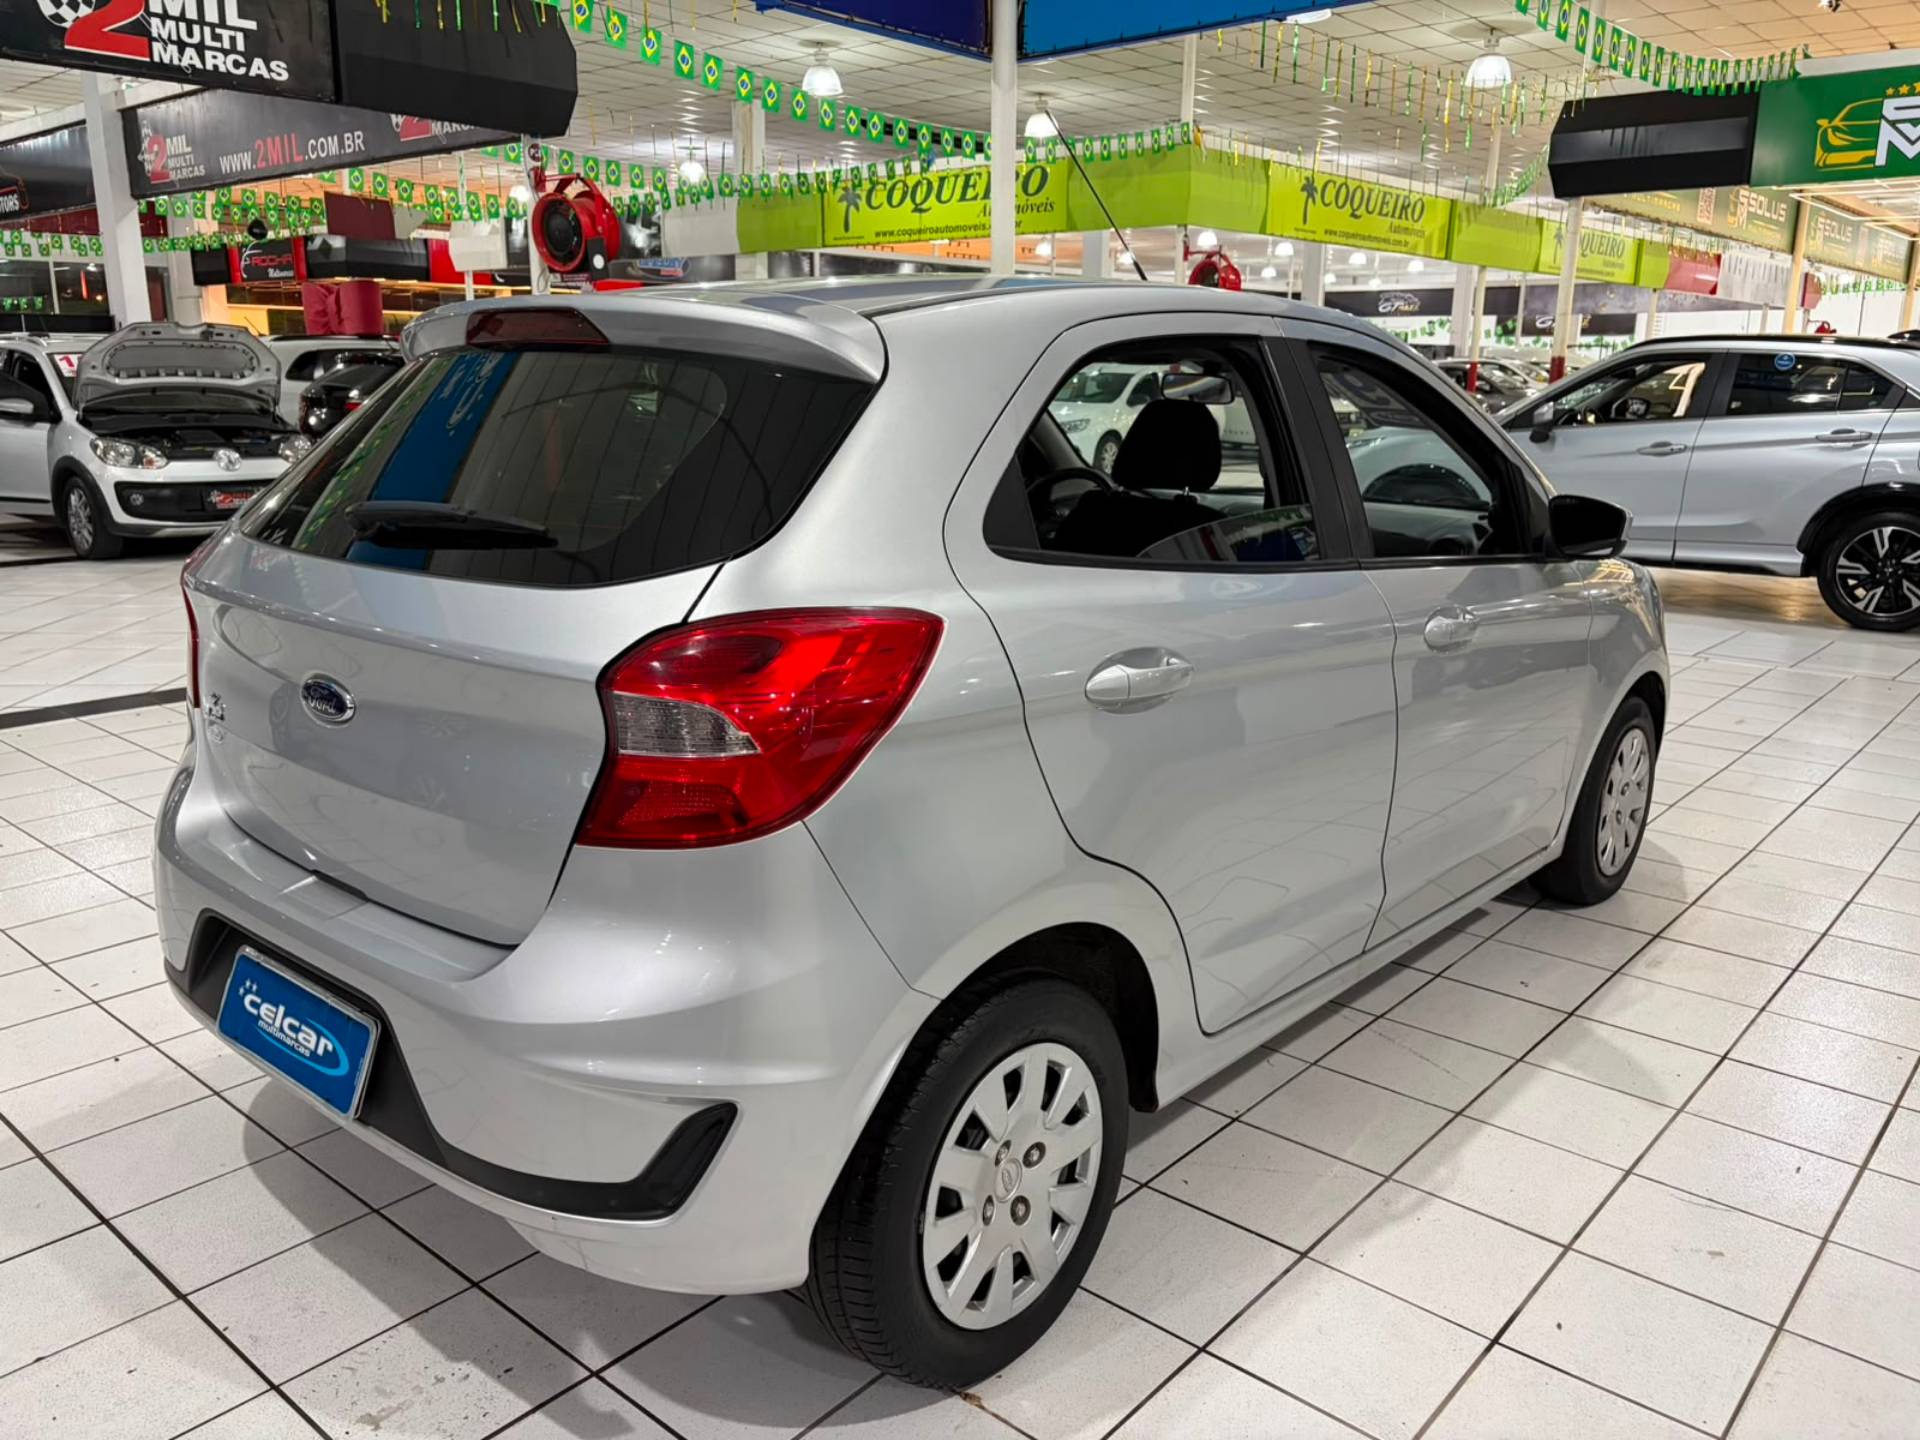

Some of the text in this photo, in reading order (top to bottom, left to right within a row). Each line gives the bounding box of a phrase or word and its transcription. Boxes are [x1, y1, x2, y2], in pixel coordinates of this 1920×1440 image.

[64, 0, 258, 61] 2 MIL
[150, 17, 246, 51] MULTI
[152, 42, 289, 82] MARCAS
[166, 134, 192, 156] MIL
[168, 154, 194, 168] MULTI
[219, 131, 366, 175] WWW.2MIL.COM.BR
[170, 164, 205, 180] MARCAS
[866, 165, 1049, 214] COQUEIO
[1320, 179, 1425, 223] COQUEIRO
[1580, 231, 1626, 258] QUEIRO
[243, 993, 334, 1057] celcar
[257, 1019, 311, 1058] multimarcas
